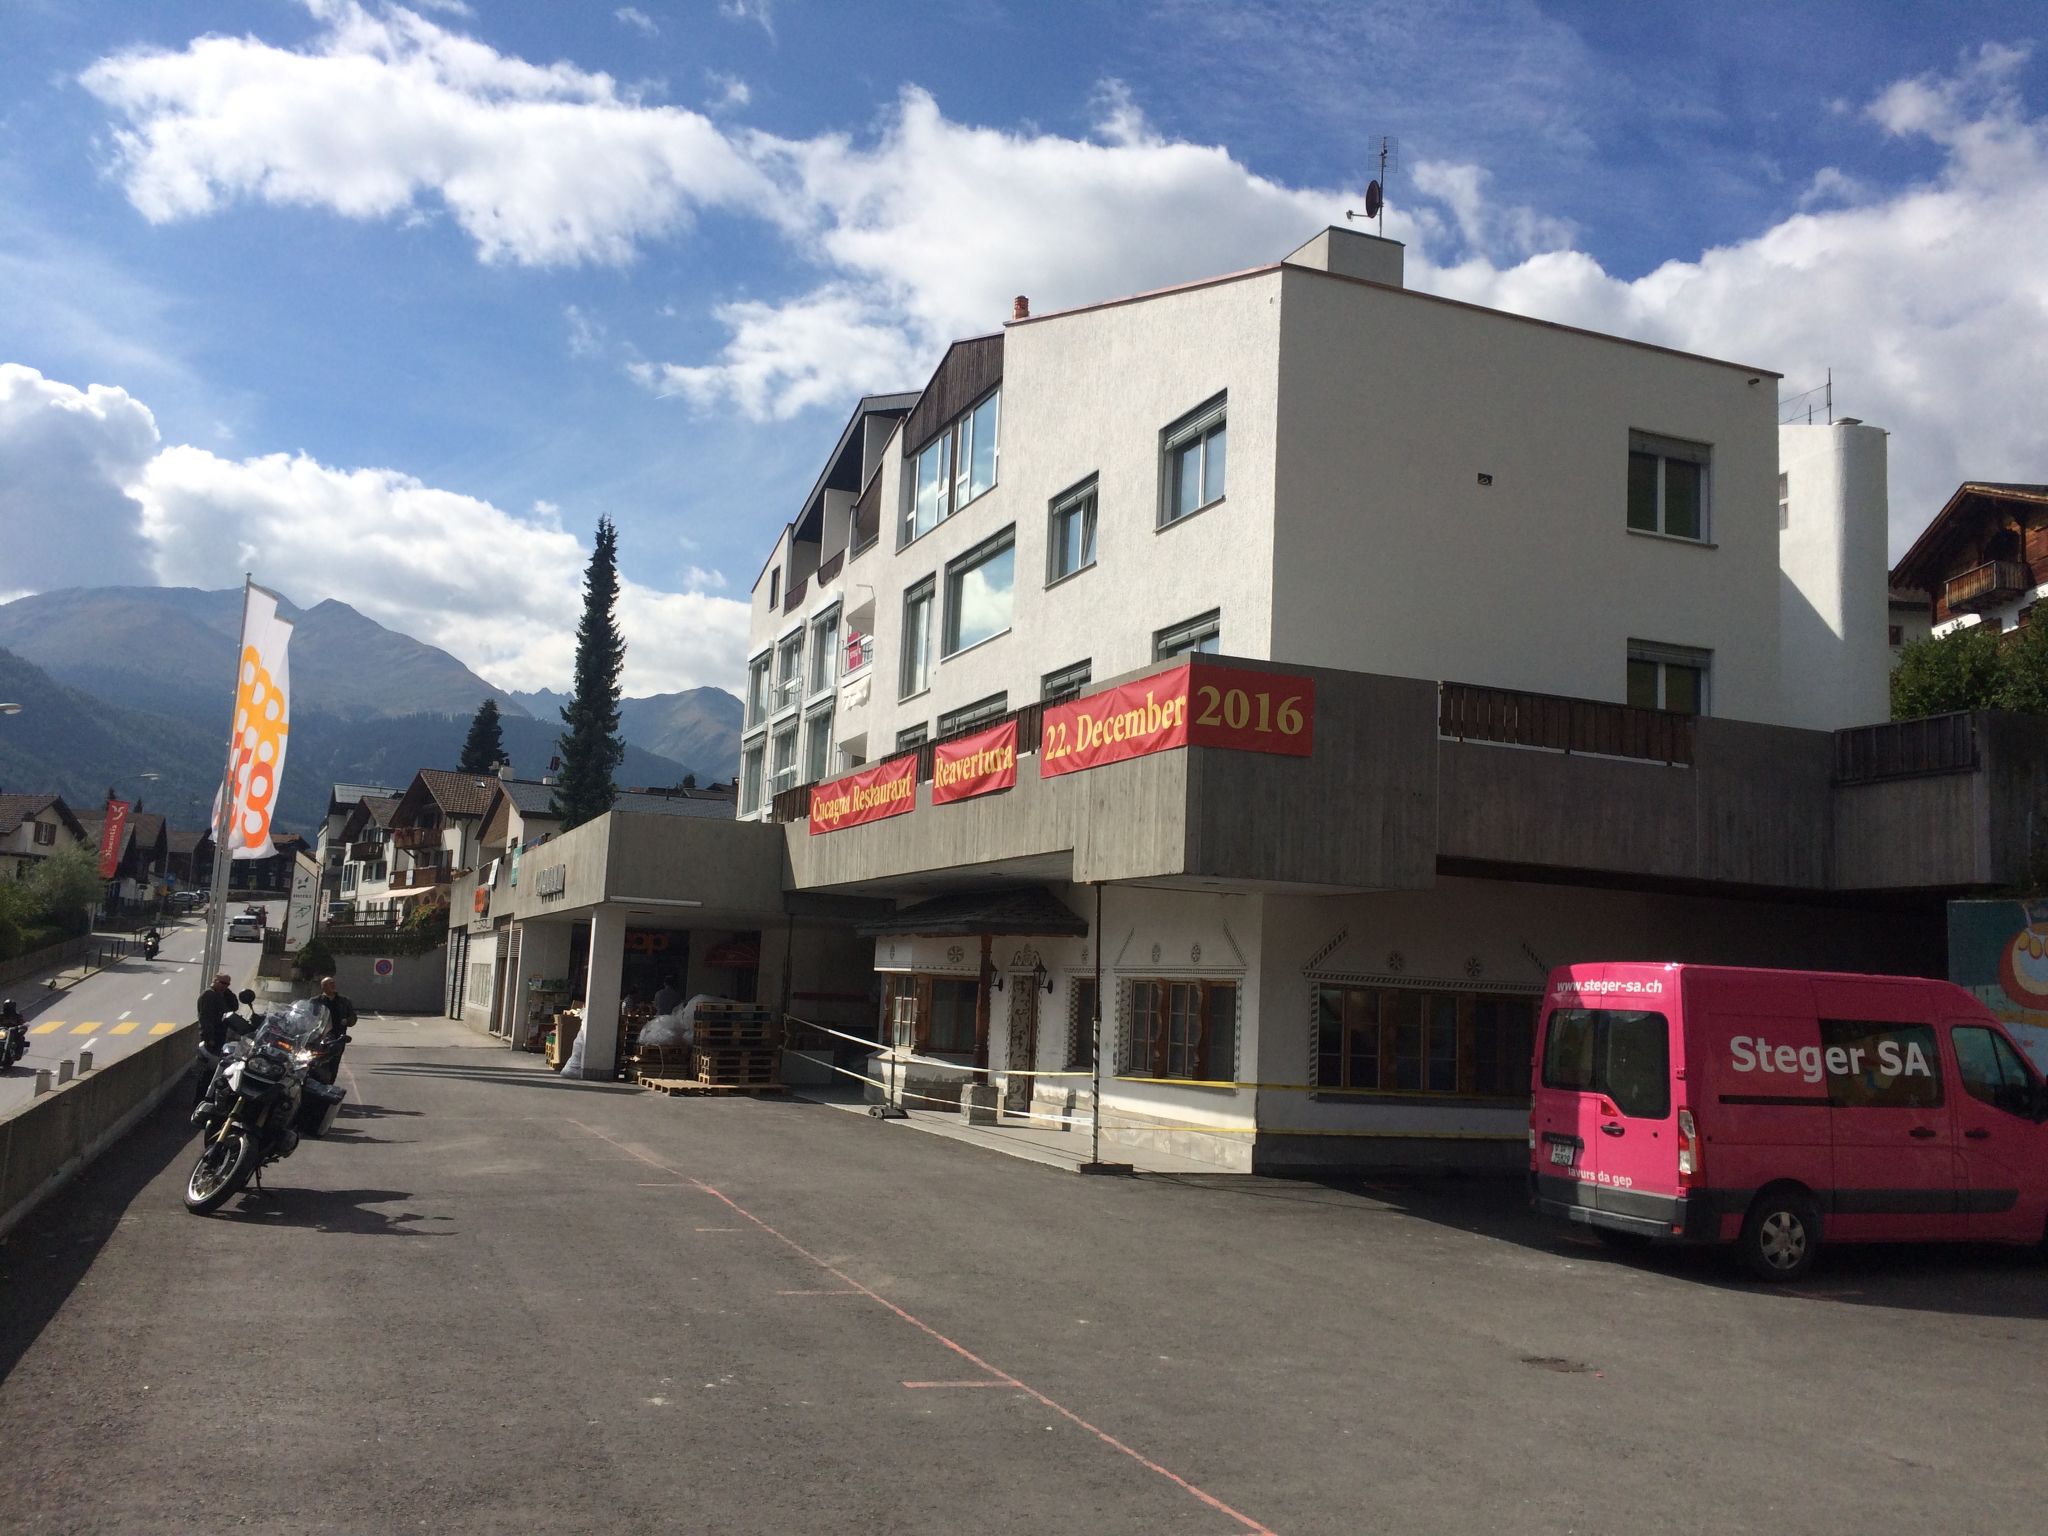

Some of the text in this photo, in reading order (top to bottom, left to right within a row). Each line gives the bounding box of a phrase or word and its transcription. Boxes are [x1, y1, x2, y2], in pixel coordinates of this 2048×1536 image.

[1045, 690, 1187, 761] 22. December
[1195, 685, 1304, 735] 2016
[934, 744, 1014, 789] Reavertura
[813, 771, 912, 825] Cucagna Restaurant
[1557, 979, 1663, 995] www.steger-sa.ch
[1730, 1035, 1932, 1083] Steger SA
[1598, 1170, 1611, 1183] da
[1613, 1175, 1633, 1188] gep
